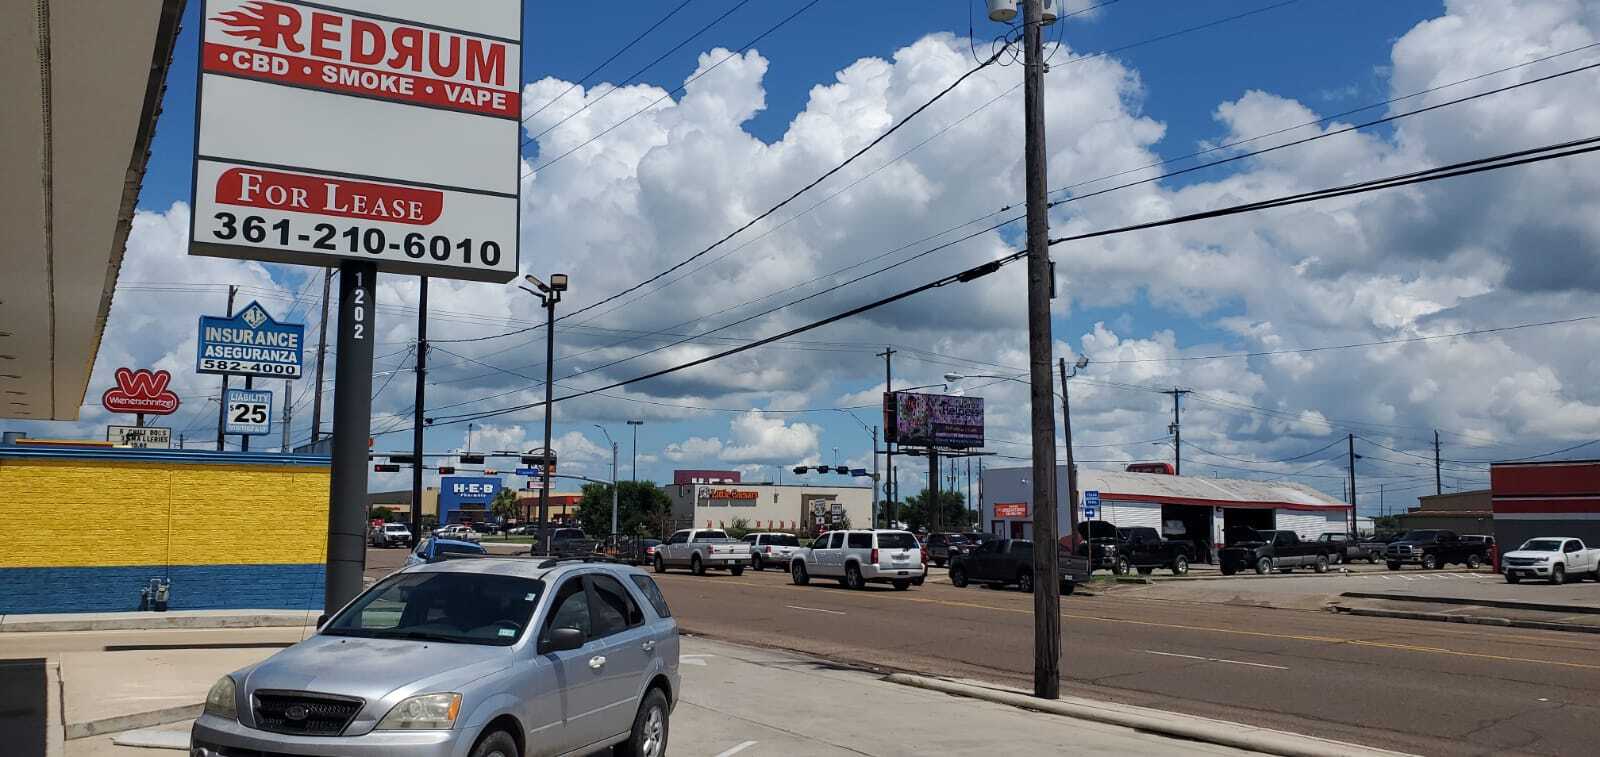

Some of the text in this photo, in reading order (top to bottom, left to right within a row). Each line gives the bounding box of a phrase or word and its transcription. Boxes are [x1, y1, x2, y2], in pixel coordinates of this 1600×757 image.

[232, 51, 506, 110] CBD SMOKE VAPE
[212, 212, 501, 266] 361-210-6010
[353, 271, 365, 340] 1202
[205, 327, 298, 348] INSURANCE
[204, 345, 297, 363] ASEGURANZA
[203, 359, 296, 375] 582-4000
[109, 396, 174, 409] Wienerschnitzel
[230, 392, 269, 402] LIABILITY
